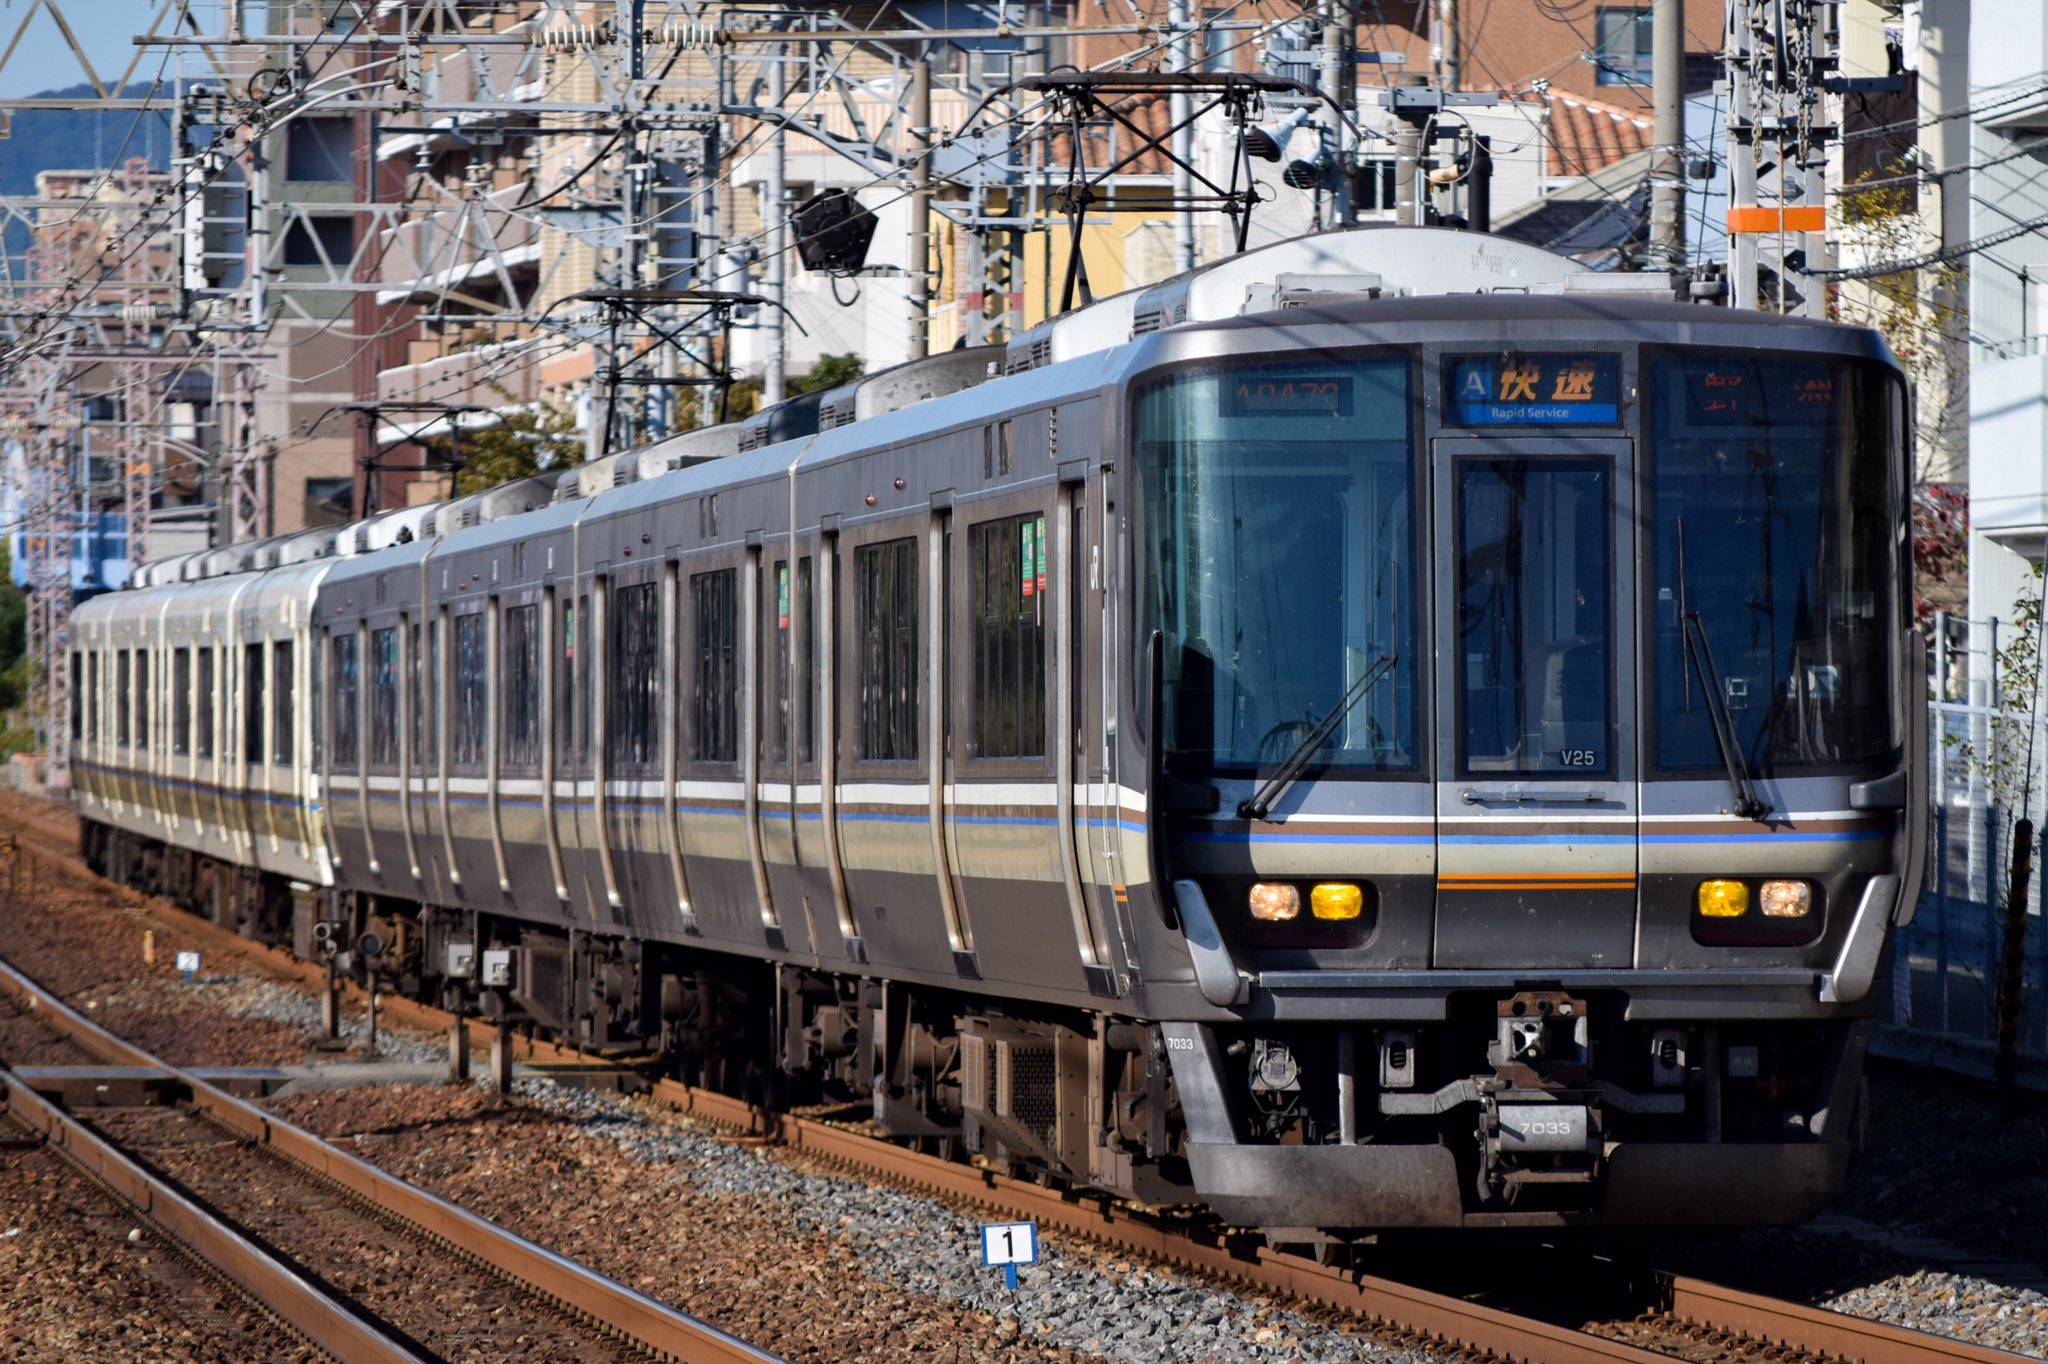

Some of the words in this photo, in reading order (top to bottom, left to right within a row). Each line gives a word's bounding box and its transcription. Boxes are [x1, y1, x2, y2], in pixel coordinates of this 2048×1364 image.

[1460, 370, 1486, 396] A
[1499, 360, 1597, 401] 快速
[1491, 407, 1525, 420] Rapid
[1528, 407, 1569, 418] Service
[1561, 749, 1595, 766] V25
[1168, 1037, 1194, 1050] 7033
[1520, 1122, 1571, 1135] 7033
[1002, 1230, 1014, 1258] 1
